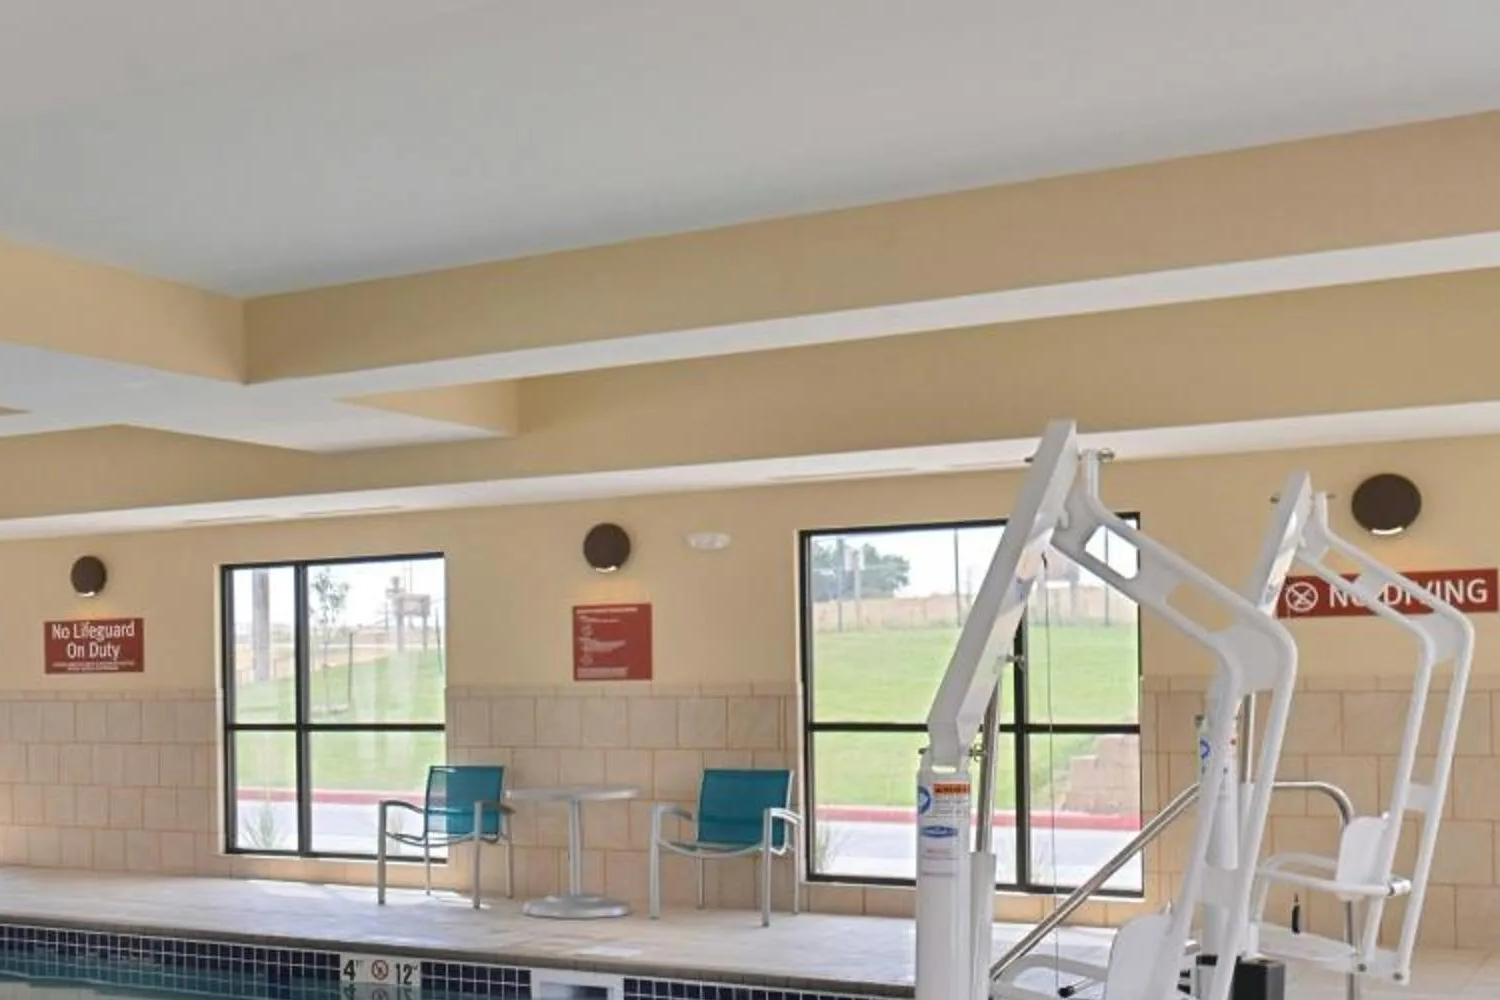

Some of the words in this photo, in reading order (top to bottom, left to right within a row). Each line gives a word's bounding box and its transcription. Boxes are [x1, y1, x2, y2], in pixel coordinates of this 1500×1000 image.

[51, 623, 70, 639] No
[73, 620, 135, 642] Lifeguard
[67, 642, 85, 658] On
[89, 641, 120, 661] Duty
[343, 959, 356, 982] 4
